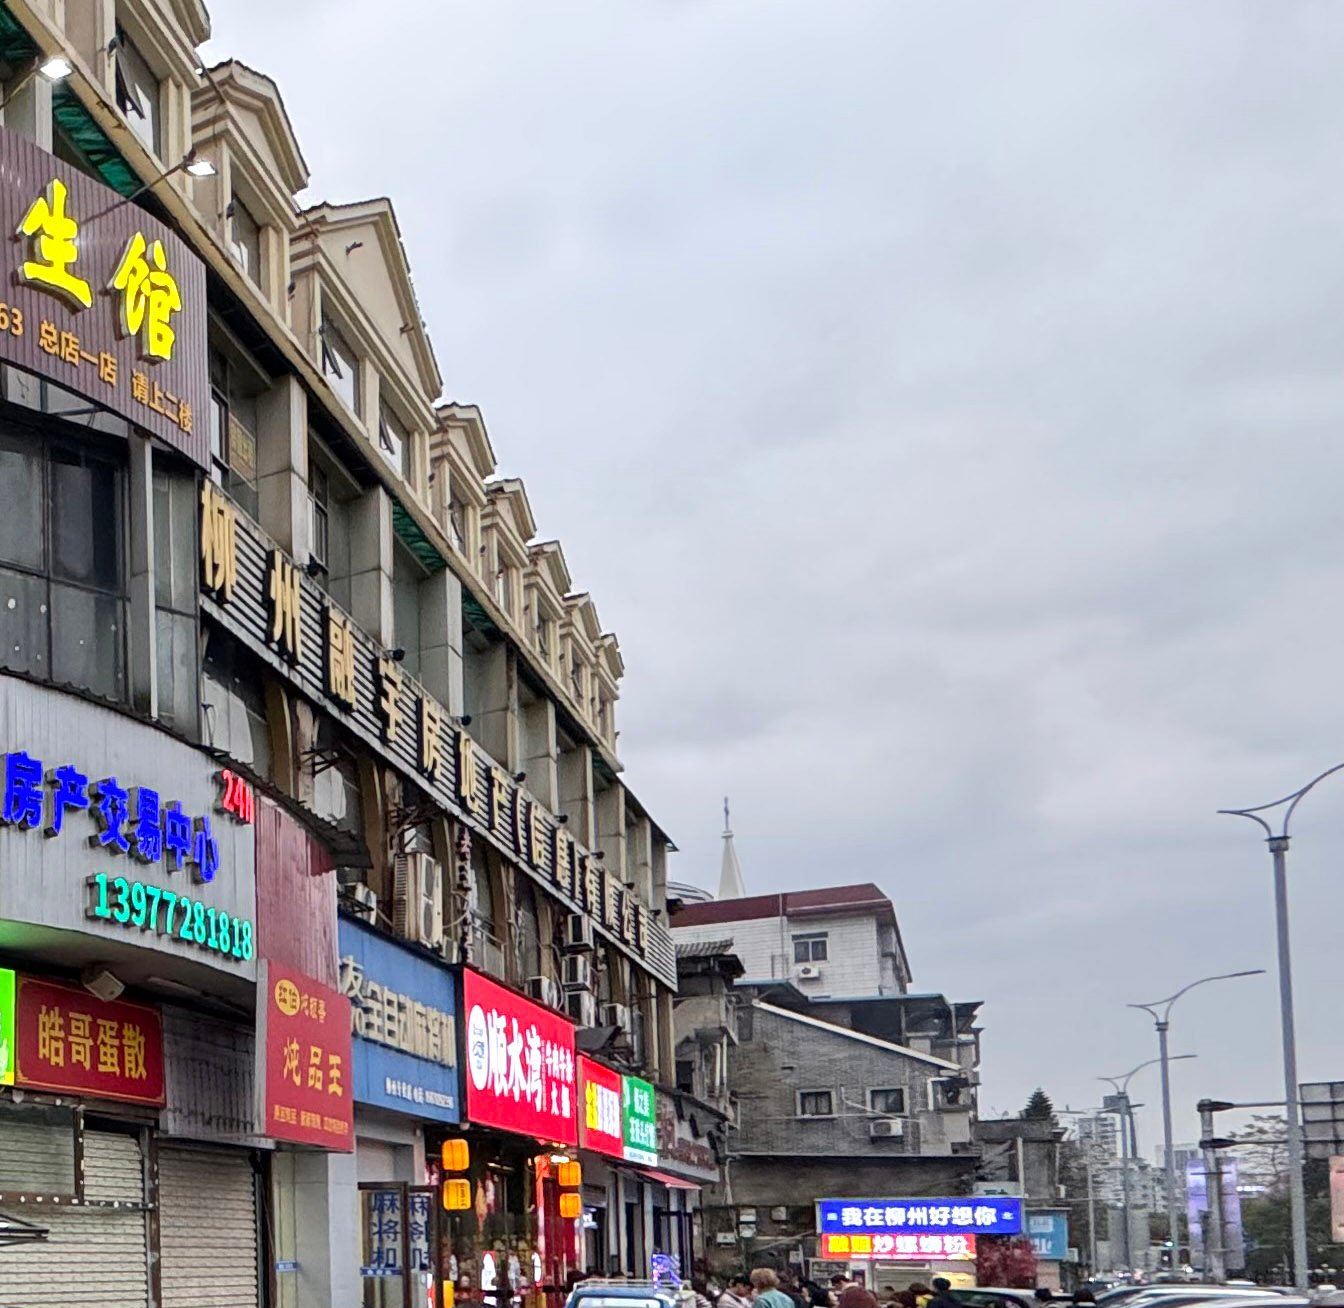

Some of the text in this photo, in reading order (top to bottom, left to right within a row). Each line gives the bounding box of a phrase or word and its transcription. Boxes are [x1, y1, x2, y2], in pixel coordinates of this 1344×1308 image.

[39, 319, 119, 386] 总店一店
[92, 873, 254, 961] 13977281818
[38, 1004, 148, 1081] 皓哥蛋散
[841, 1206, 998, 1227] 我在柳州好想你
